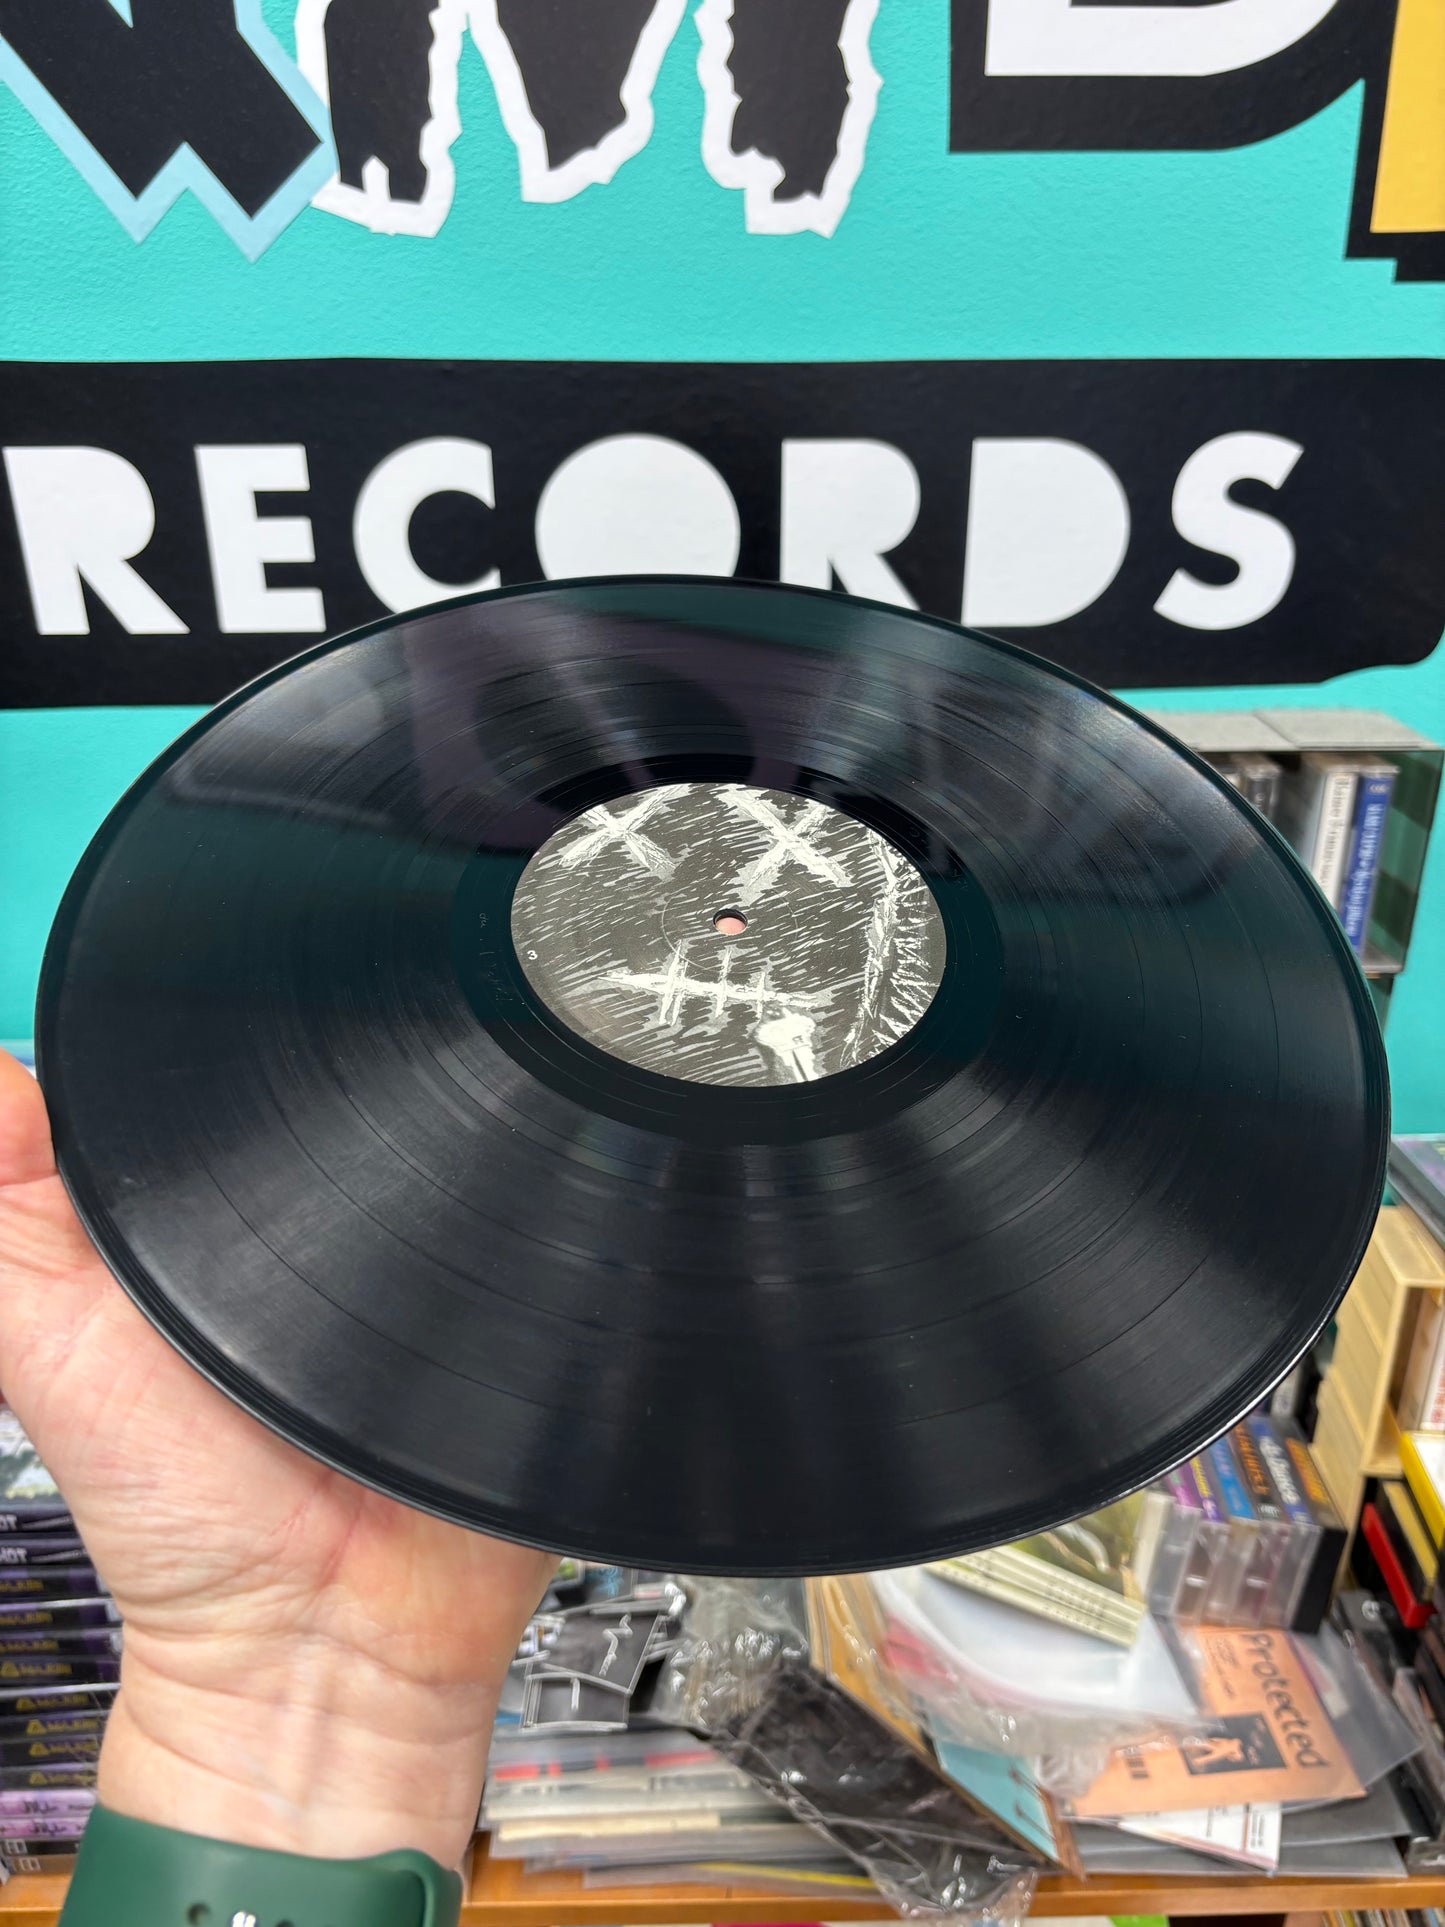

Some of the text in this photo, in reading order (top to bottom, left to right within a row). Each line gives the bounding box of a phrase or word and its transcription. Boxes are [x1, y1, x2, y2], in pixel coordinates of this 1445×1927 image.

[2, 431, 1304, 635] RECORDS
[526, 949, 539, 961] 3
[1239, 1632, 1331, 1767] Protected
